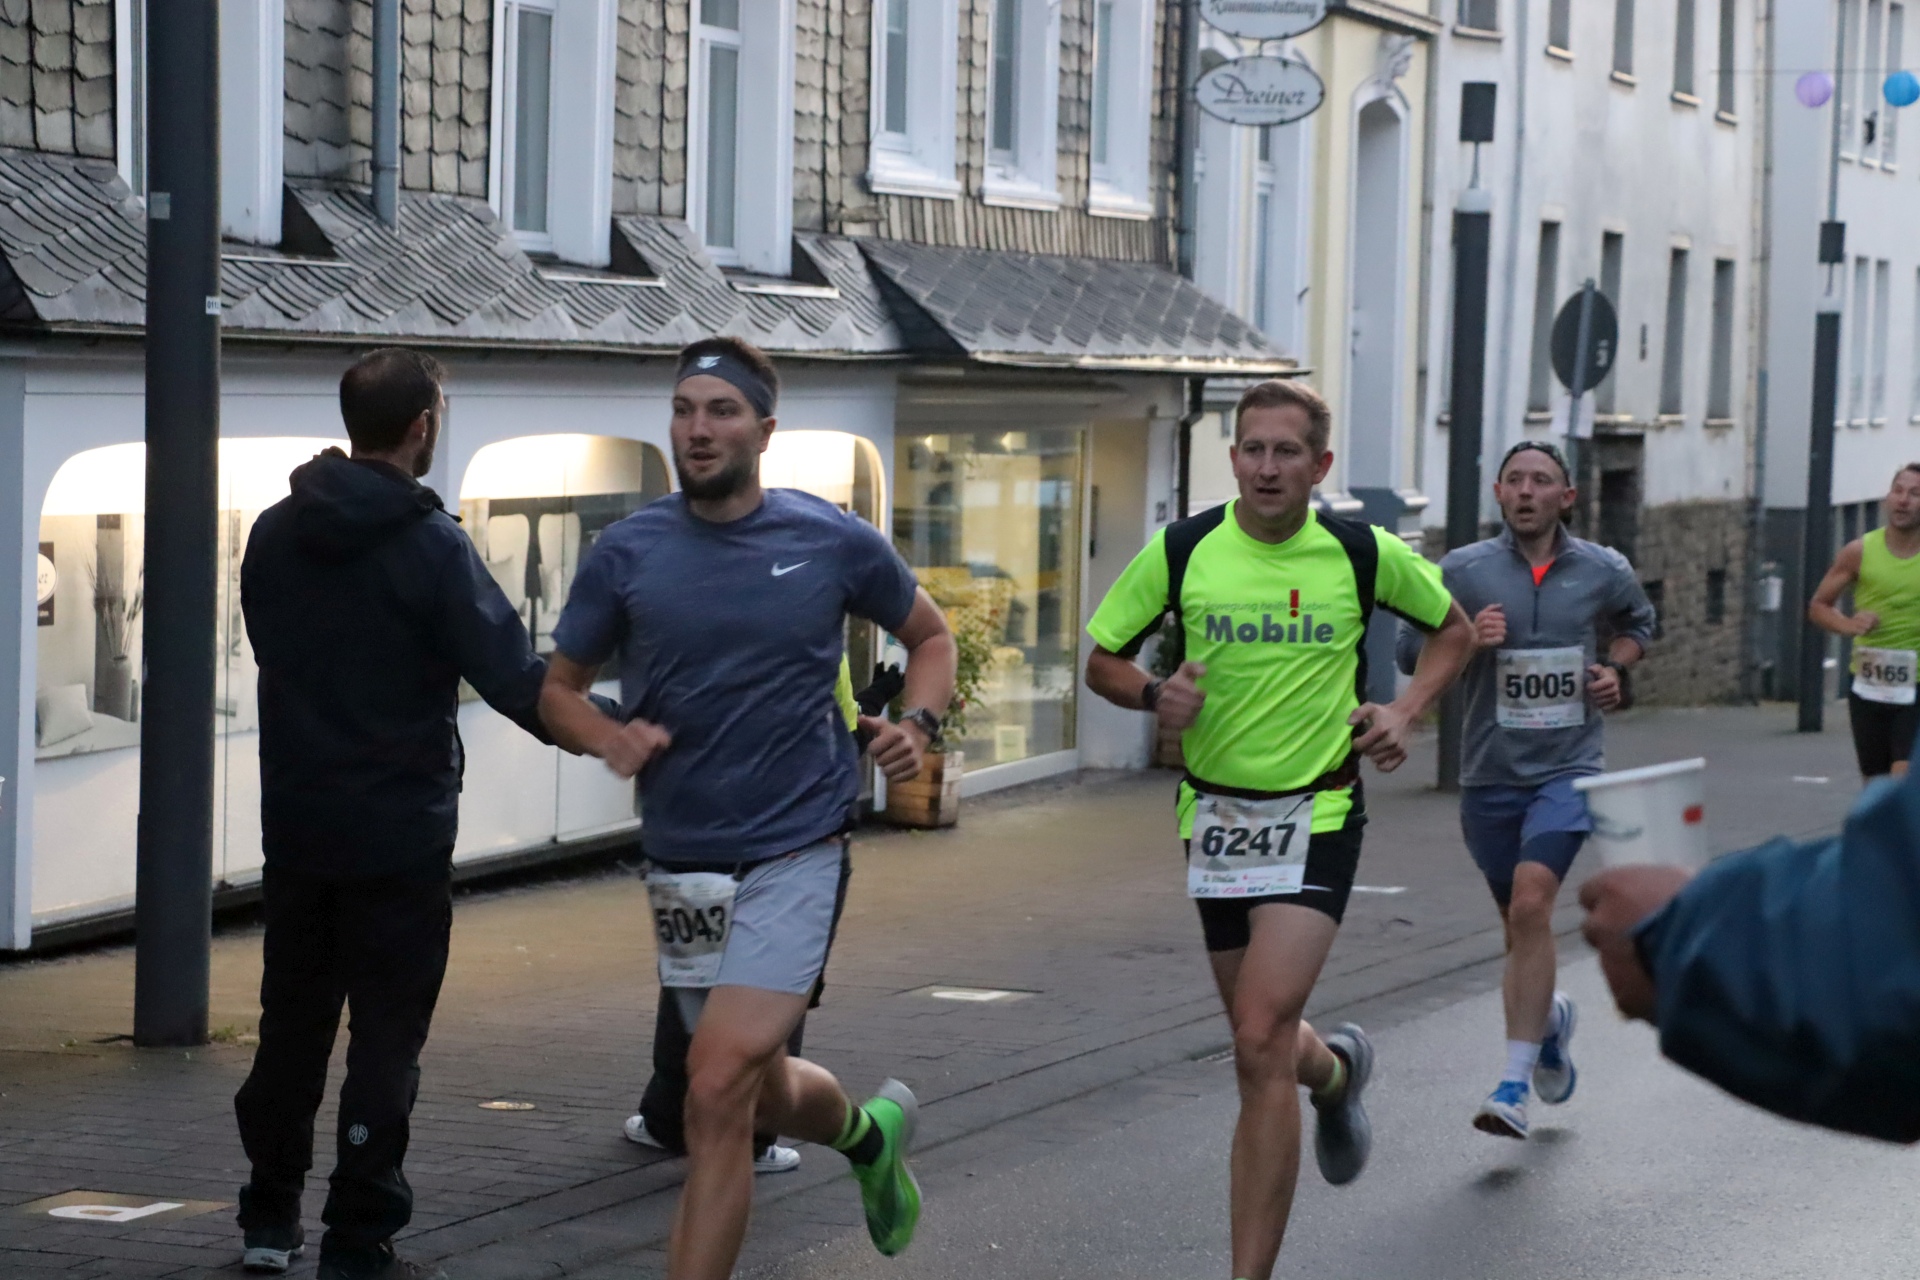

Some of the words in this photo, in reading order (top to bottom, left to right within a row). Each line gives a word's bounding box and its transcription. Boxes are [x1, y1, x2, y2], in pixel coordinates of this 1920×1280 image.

[1211, 72, 1305, 105] Dreiner
[1505, 672, 1576, 699] 5005
[1862, 662, 1909, 683] 5165
[1201, 822, 1297, 856] 6247
[655, 906, 725, 944] 5043
